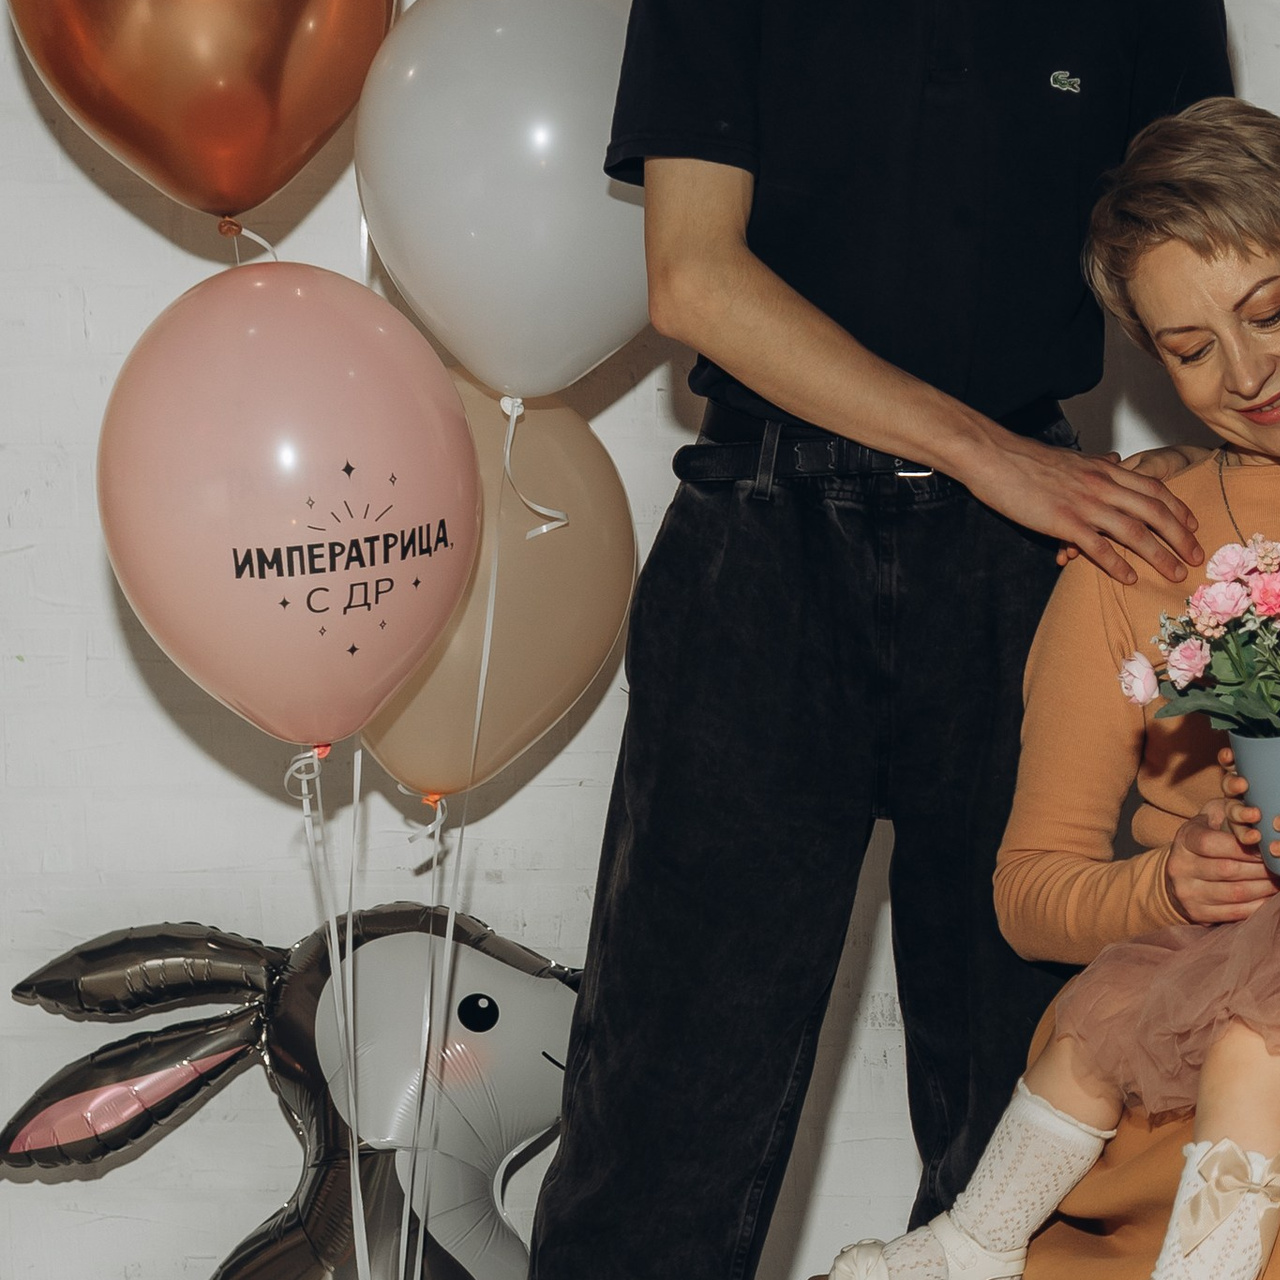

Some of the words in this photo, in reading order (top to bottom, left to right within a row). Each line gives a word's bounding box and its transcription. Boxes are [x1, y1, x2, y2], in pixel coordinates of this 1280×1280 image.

[232, 518, 454, 580] ИМПЕРАТРИЦА,
[306, 587, 330, 613] С
[343, 577, 394, 615] ДР
